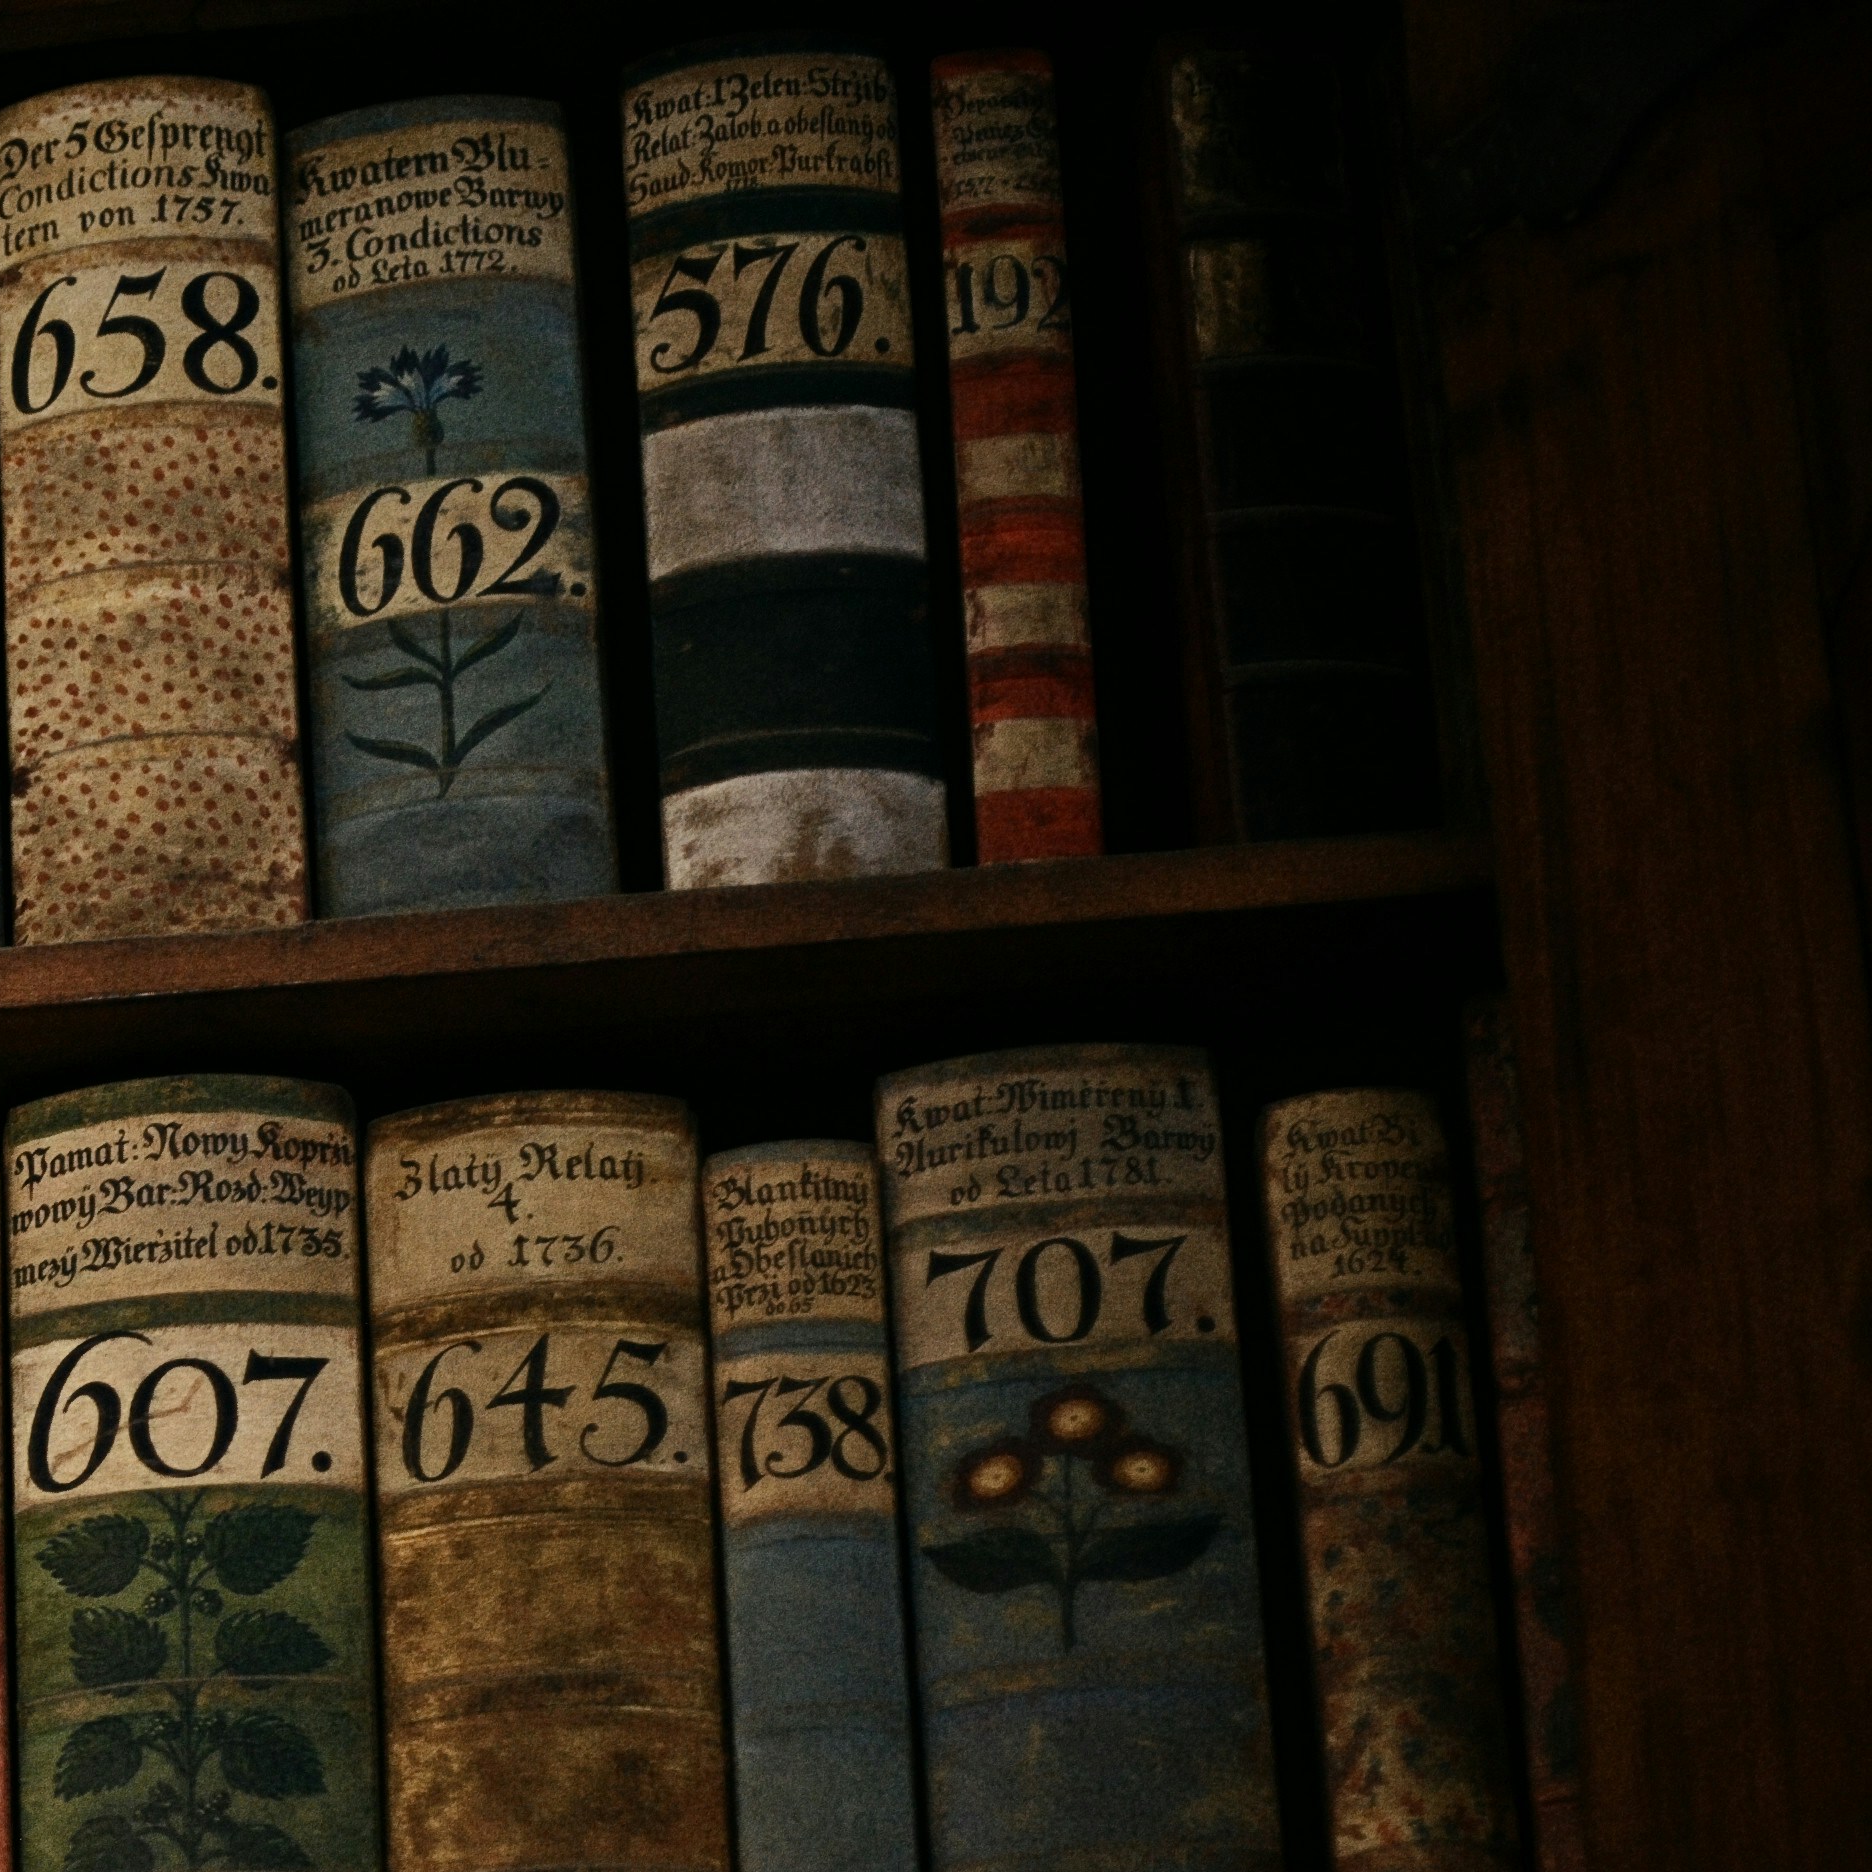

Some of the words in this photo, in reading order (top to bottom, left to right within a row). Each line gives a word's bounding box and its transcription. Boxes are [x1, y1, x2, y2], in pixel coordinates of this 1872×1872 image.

[78, 204, 136, 234] von
[150, 194, 245, 227] 1757.
[298, 188, 453, 243] meranowe
[306, 237, 341, 274] 3.
[346, 214, 543, 263] Condictions
[332, 266, 361, 293] od
[439, 248, 518, 275] 1772.
[650, 235, 891, 375] 576.
[11, 265, 279, 416] 658.
[338, 475, 587, 618] 662.
[225, 1232, 259, 1259] od
[258, 1221, 350, 1259] 1735.
[487, 1182, 534, 1224] 4.
[450, 1248, 485, 1274] od
[507, 1224, 624, 1269] 1736.
[926, 1231, 1216, 1354] 707.
[27, 1329, 333, 1494] 607.
[401, 1332, 688, 1484] 645.
[1298, 1327, 1472, 1468] 691
